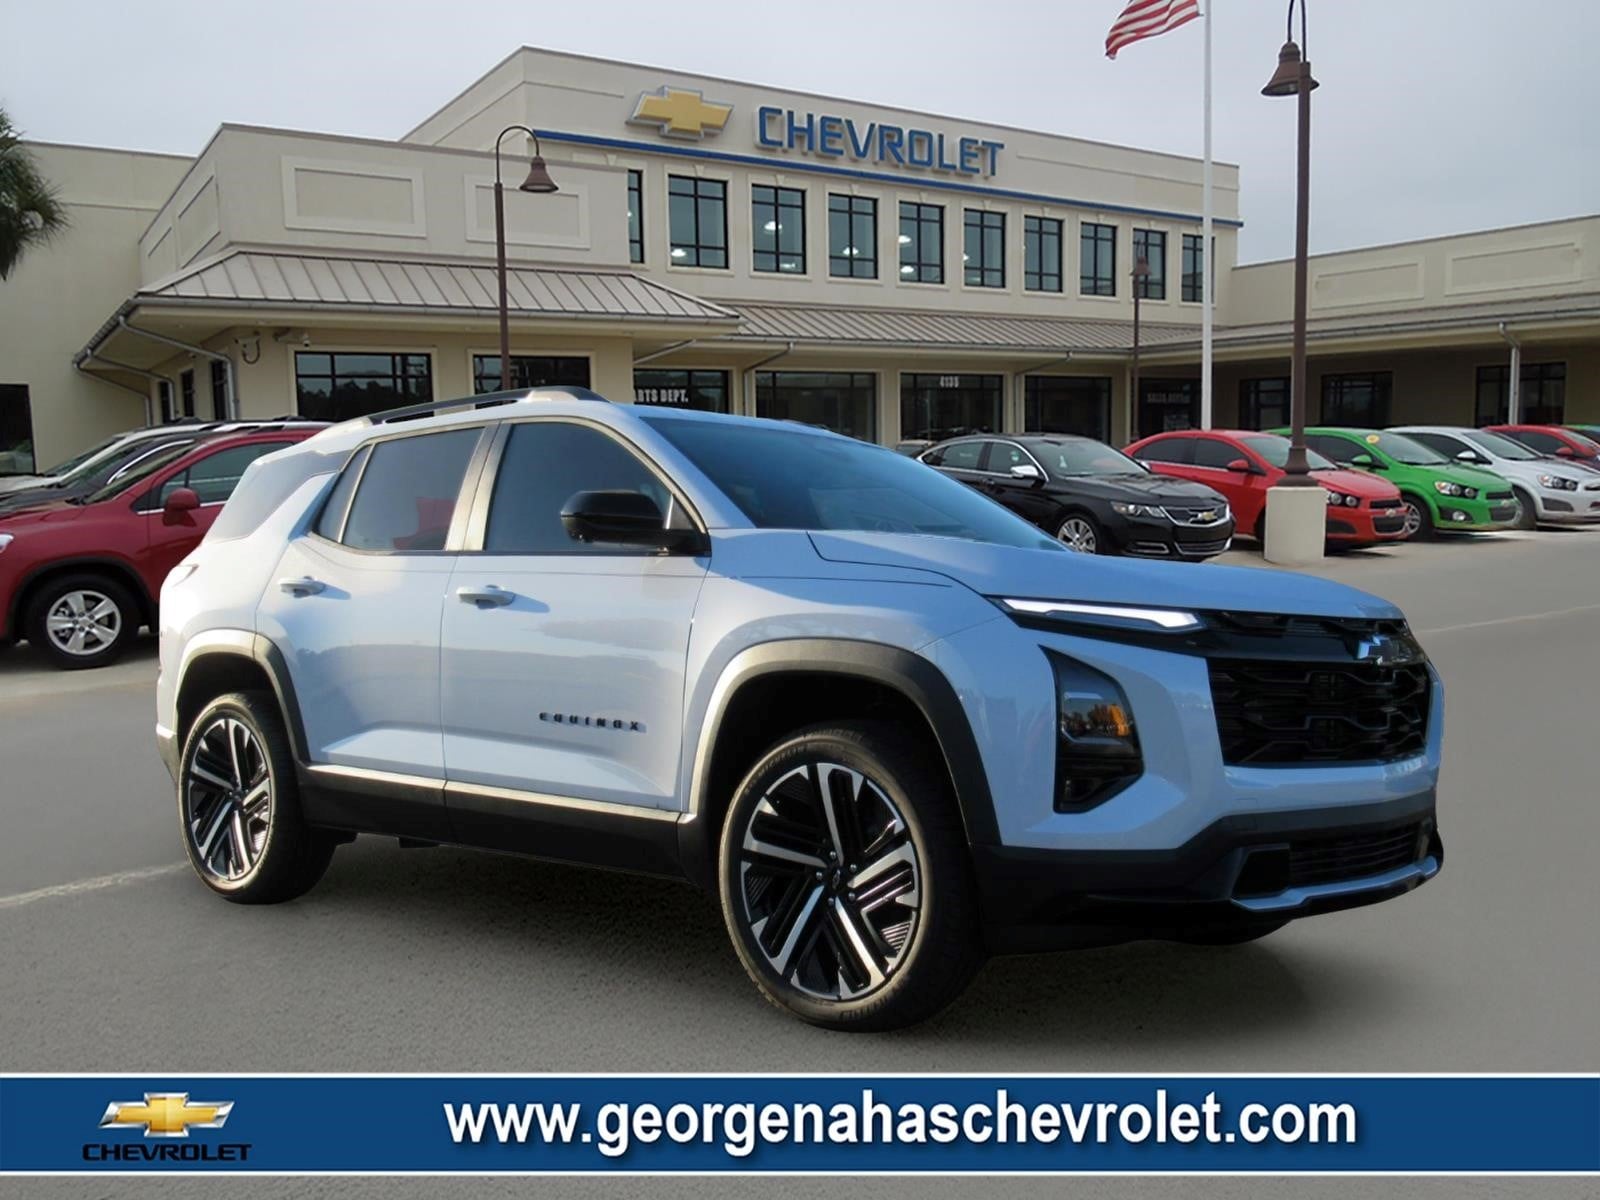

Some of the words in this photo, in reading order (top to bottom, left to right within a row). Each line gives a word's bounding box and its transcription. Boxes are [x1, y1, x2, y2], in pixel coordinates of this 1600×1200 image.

[757, 105, 1005, 176] CHEVROLET
[660, 388, 688, 402] DEPT.
[538, 712, 639, 731] EQUINOX
